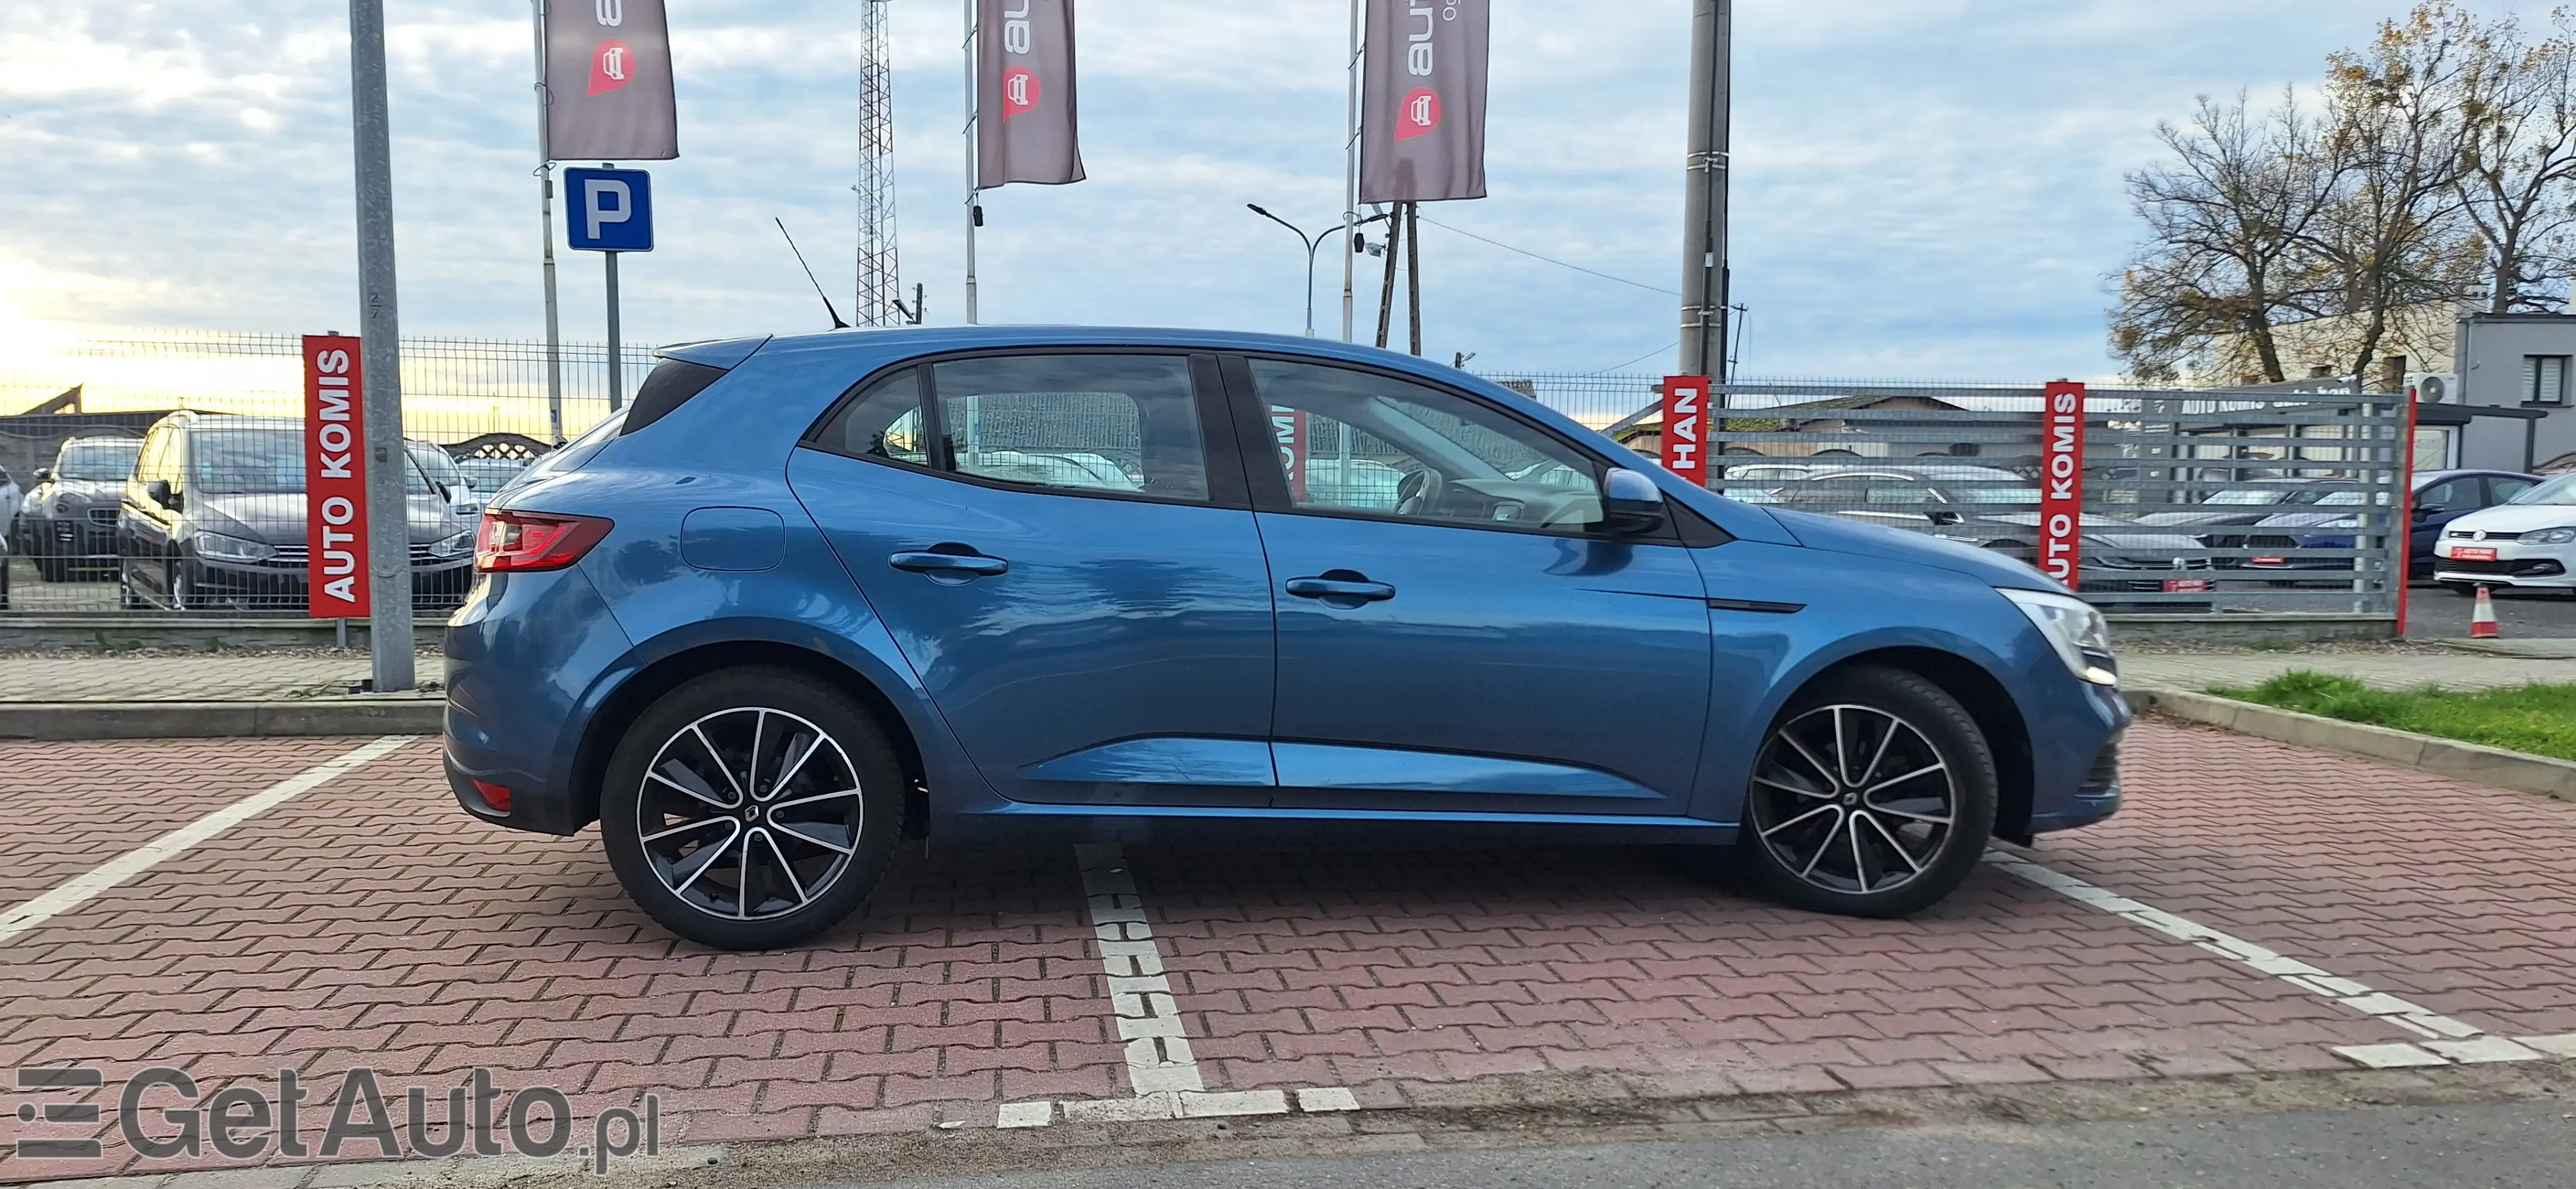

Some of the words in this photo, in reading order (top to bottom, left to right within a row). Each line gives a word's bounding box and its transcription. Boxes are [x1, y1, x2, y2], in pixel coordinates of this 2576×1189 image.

[584, 179, 631, 239] P
[317, 349, 352, 478] KOMIS
[1672, 388, 1697, 469] HAN
[2050, 392, 2076, 500] KOMIS
[321, 496, 356, 603] AUTO
[2047, 514, 2072, 585] UTO
